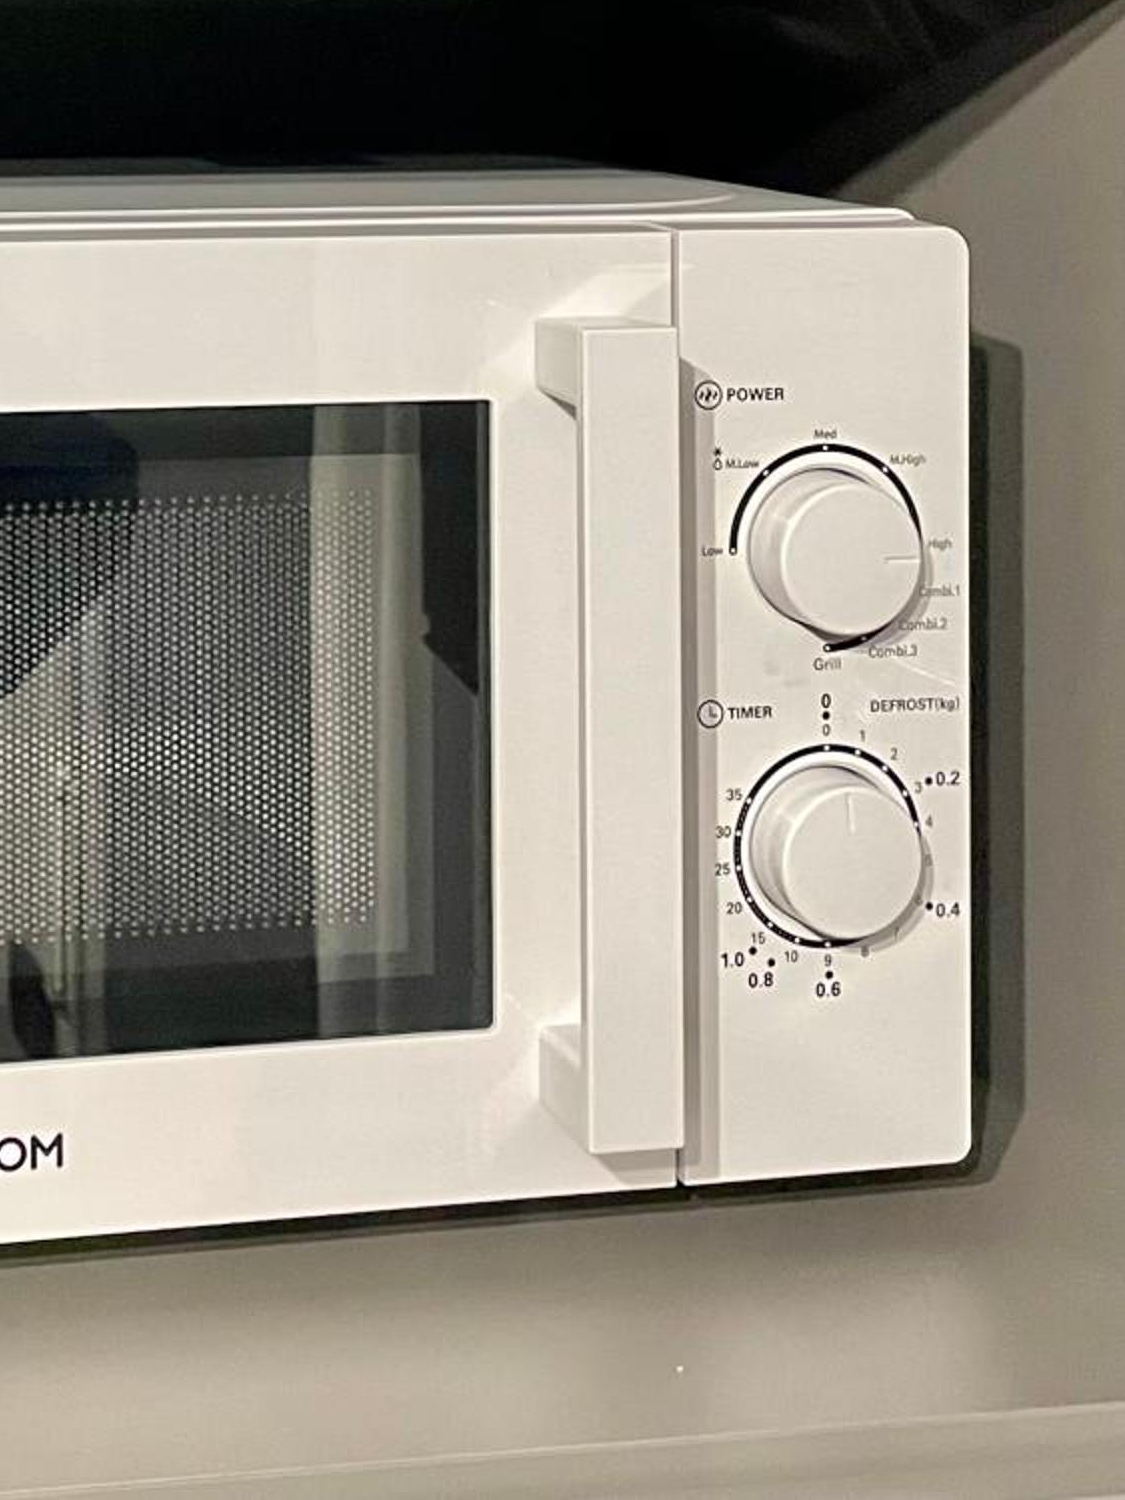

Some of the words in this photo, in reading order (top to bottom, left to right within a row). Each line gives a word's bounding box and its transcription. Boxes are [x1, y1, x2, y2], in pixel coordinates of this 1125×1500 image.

[726, 388, 785, 401] POWER
[813, 429, 838, 439] Med
[702, 547, 723, 556] Low
[813, 658, 841, 671] Grill
[821, 693, 832, 708] 0
[870, 698, 960, 714] DEFROST(kg)
[727, 706, 773, 720] TIMER
[823, 724, 831, 736] 0
[890, 749, 898, 760] 2
[936, 770, 960, 786] 0.2
[726, 789, 742, 802] 35
[716, 826, 732, 838] 30
[715, 863, 731, 876] 25
[726, 902, 742, 915] 20
[936, 902, 960, 917] 0.4
[751, 932, 766, 944] 15
[721, 952, 744, 967] 1.0
[785, 951, 798, 963] 10
[748, 972, 773, 987] 0.8
[816, 982, 841, 997] 0.6
